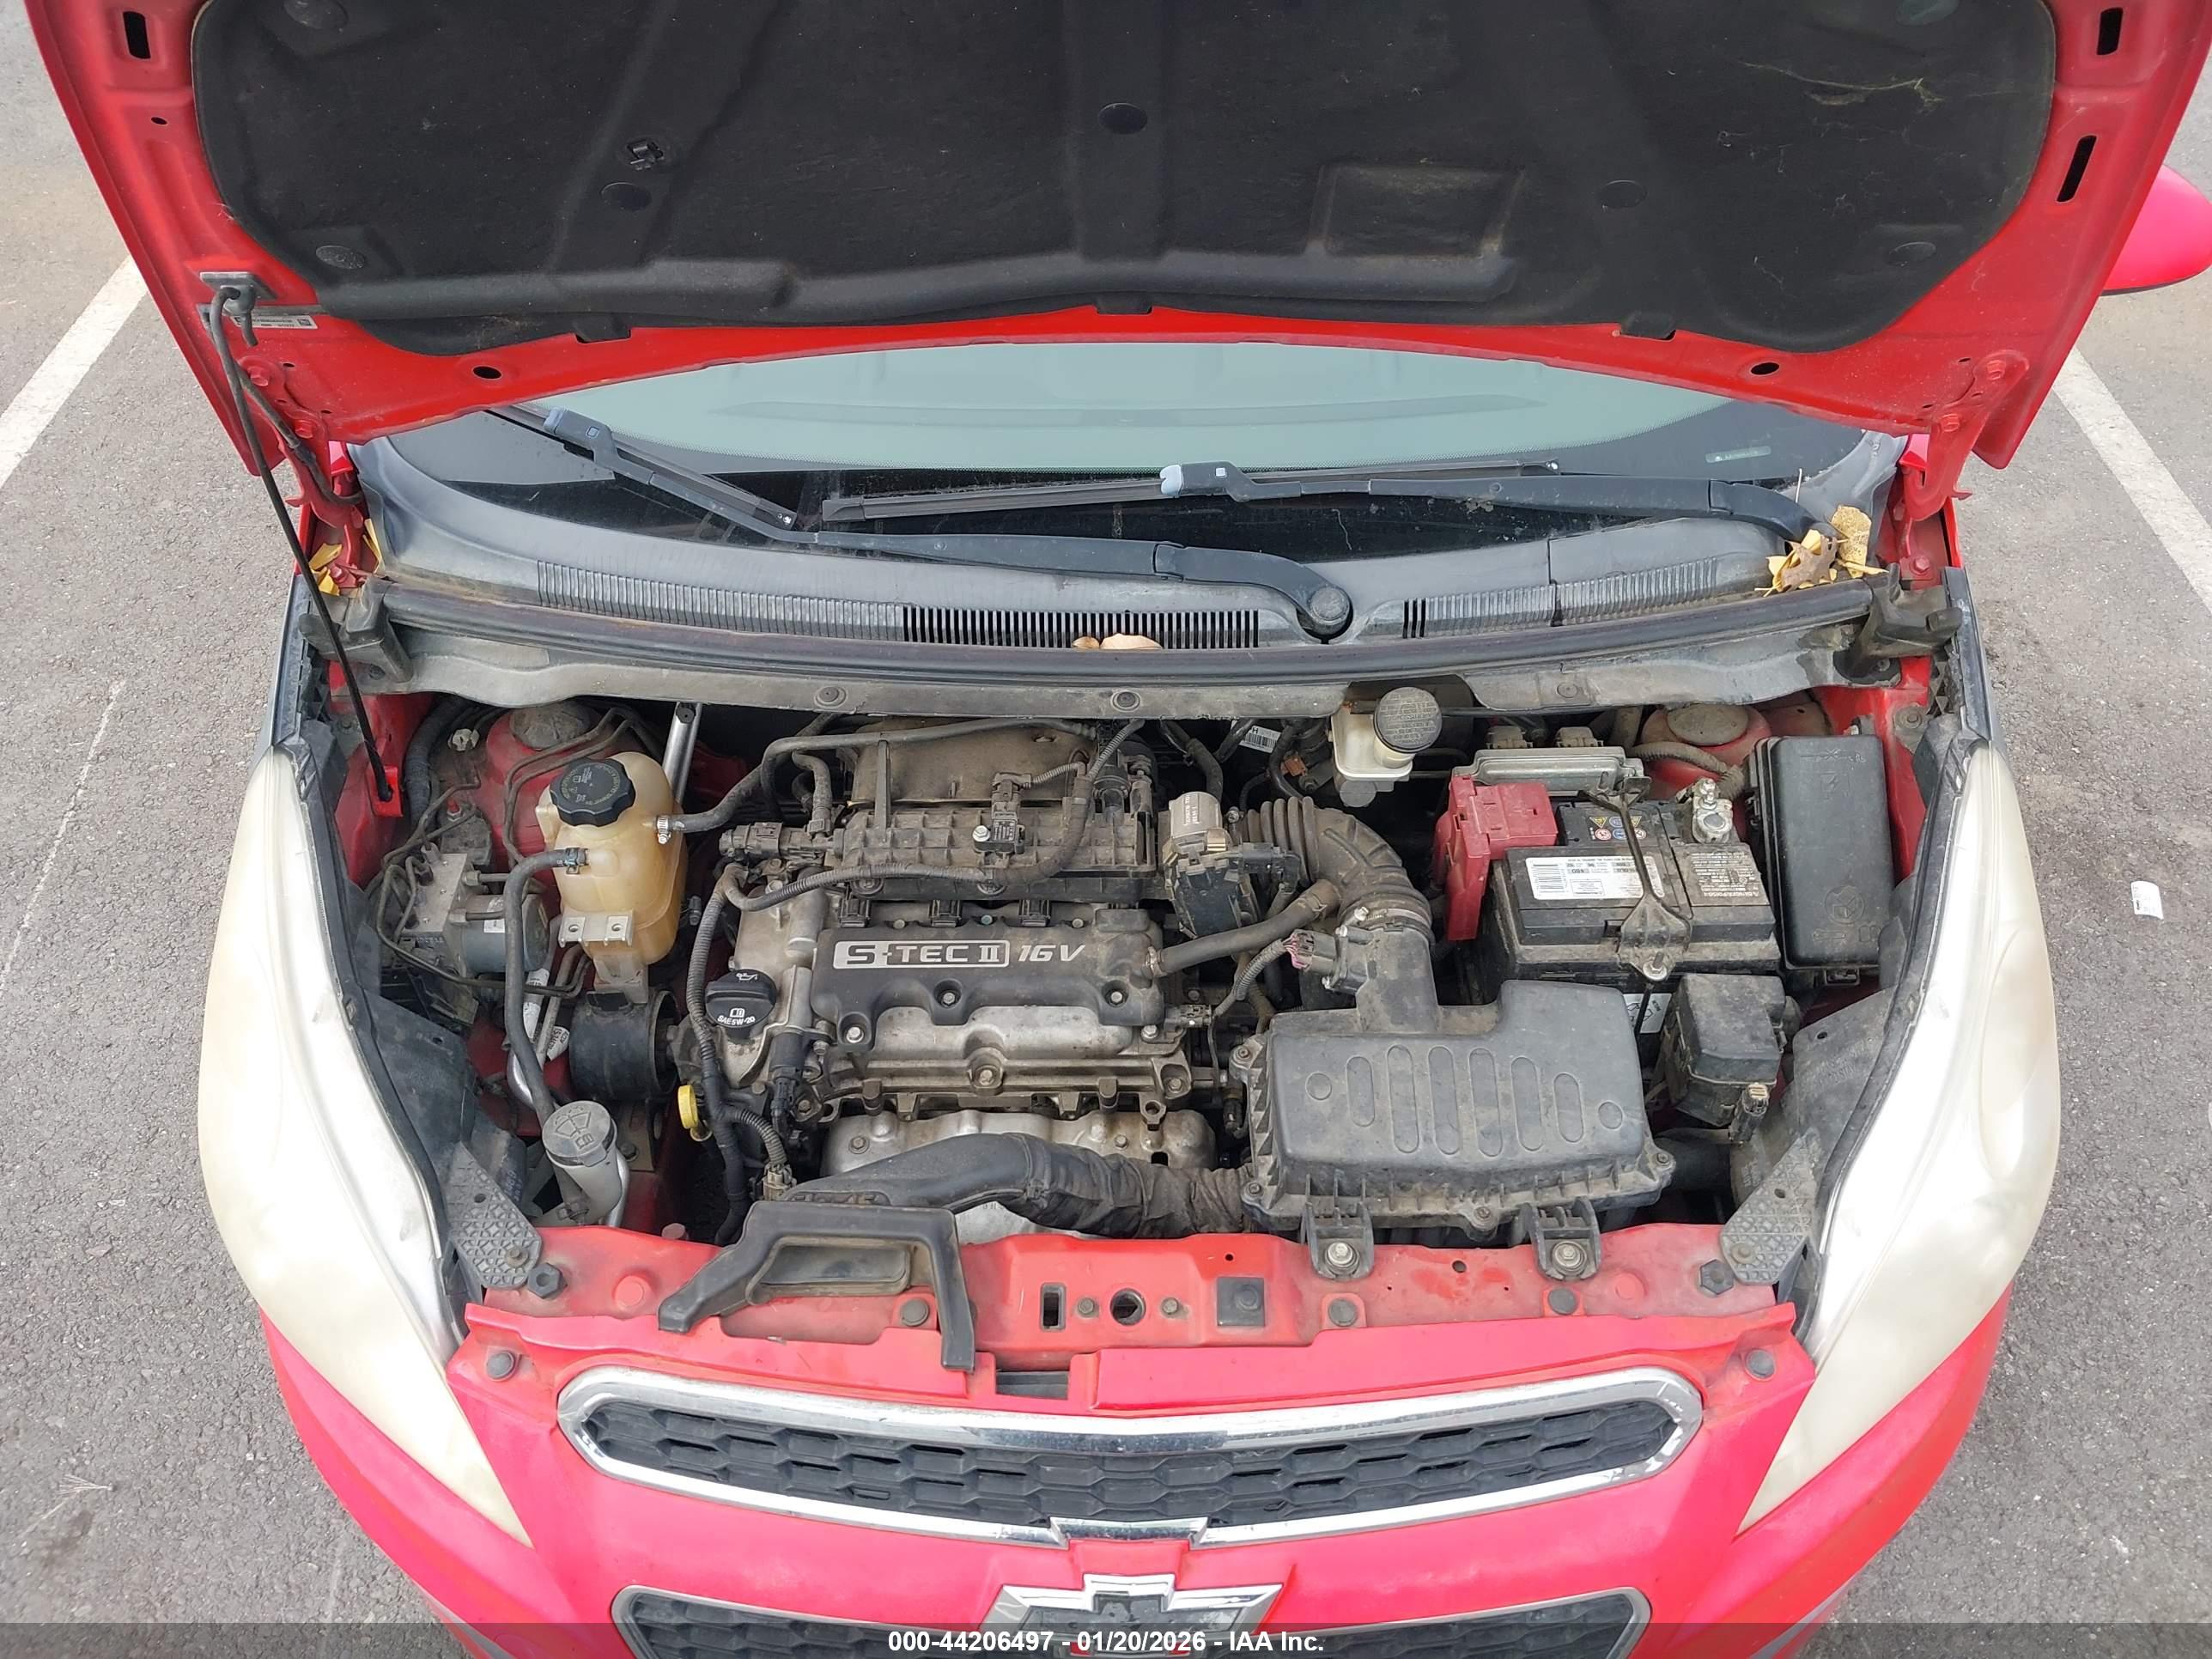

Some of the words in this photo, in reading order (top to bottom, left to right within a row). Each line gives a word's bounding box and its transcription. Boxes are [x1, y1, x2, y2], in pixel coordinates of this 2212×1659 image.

[846, 945, 969, 964] S-TEC
[978, 945, 1001, 963] II
[1018, 944, 1086, 962] 16V
[717, 1015, 732, 1024] SAE
[732, 1016, 756, 1025] 5W-20
